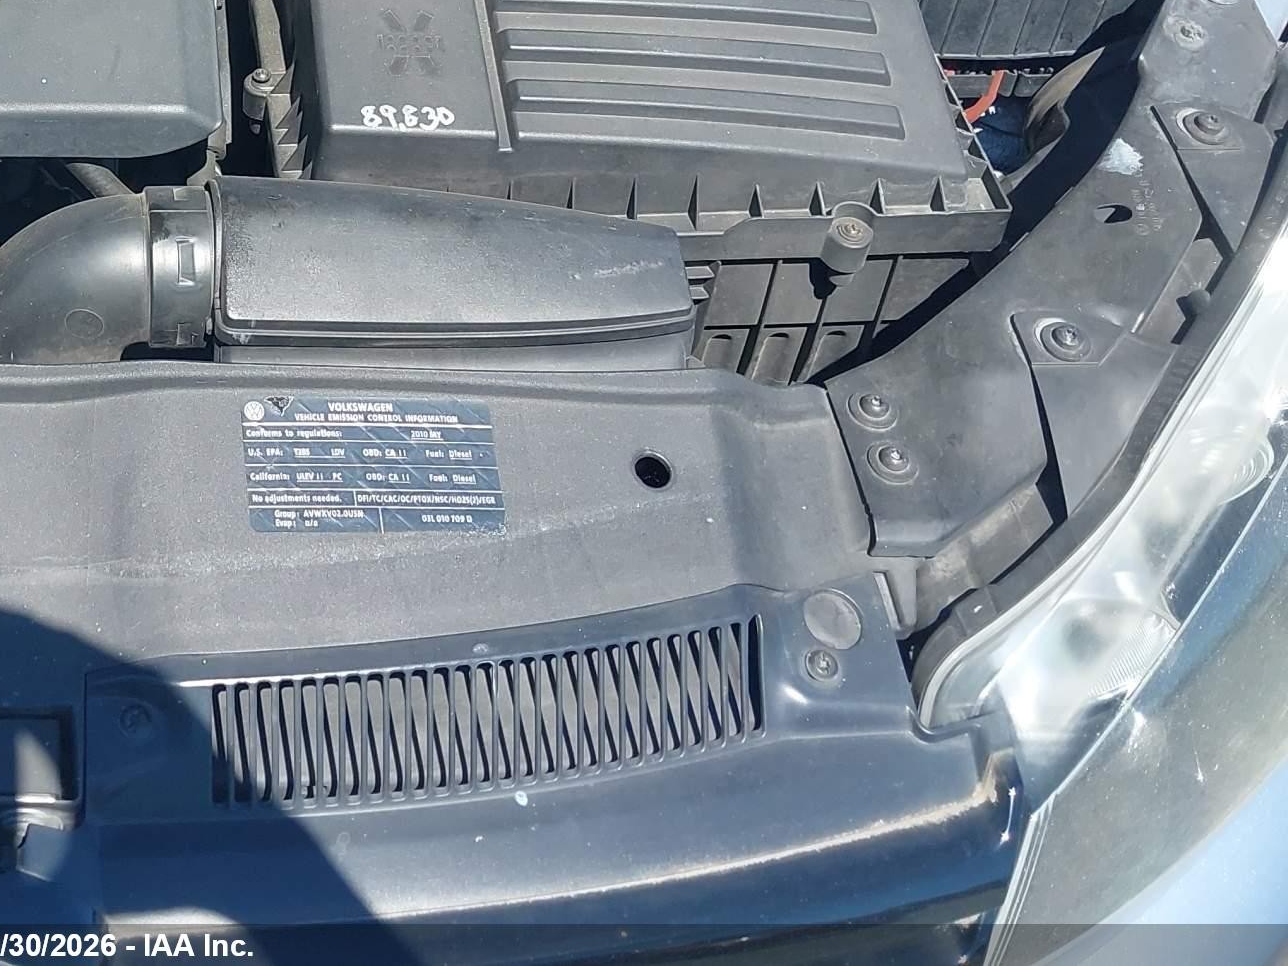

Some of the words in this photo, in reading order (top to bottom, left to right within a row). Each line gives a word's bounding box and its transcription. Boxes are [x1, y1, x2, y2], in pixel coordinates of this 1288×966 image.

[328, 402, 394, 412] VOLKSWAGEN
[294, 413, 325, 422] VEHICLE
[327, 413, 365, 422] EMISSION
[367, 414, 403, 422] CONTROL
[405, 414, 458, 423] INFORMATION
[245, 428, 282, 437] Conforms
[285, 429, 294, 437] to
[296, 428, 343, 439] regulations:
[265, 447, 284, 456] EPA:
[385, 448, 396, 457] CA
[425, 449, 445, 458] Fuel:
[449, 449, 472, 458] Diesel
[249, 472, 290, 481] California:
[453, 474, 476, 483] Diesel
[252, 494, 264, 502] No
[265, 494, 311, 504] adjustments
[312, 494, 343, 503] needed.
